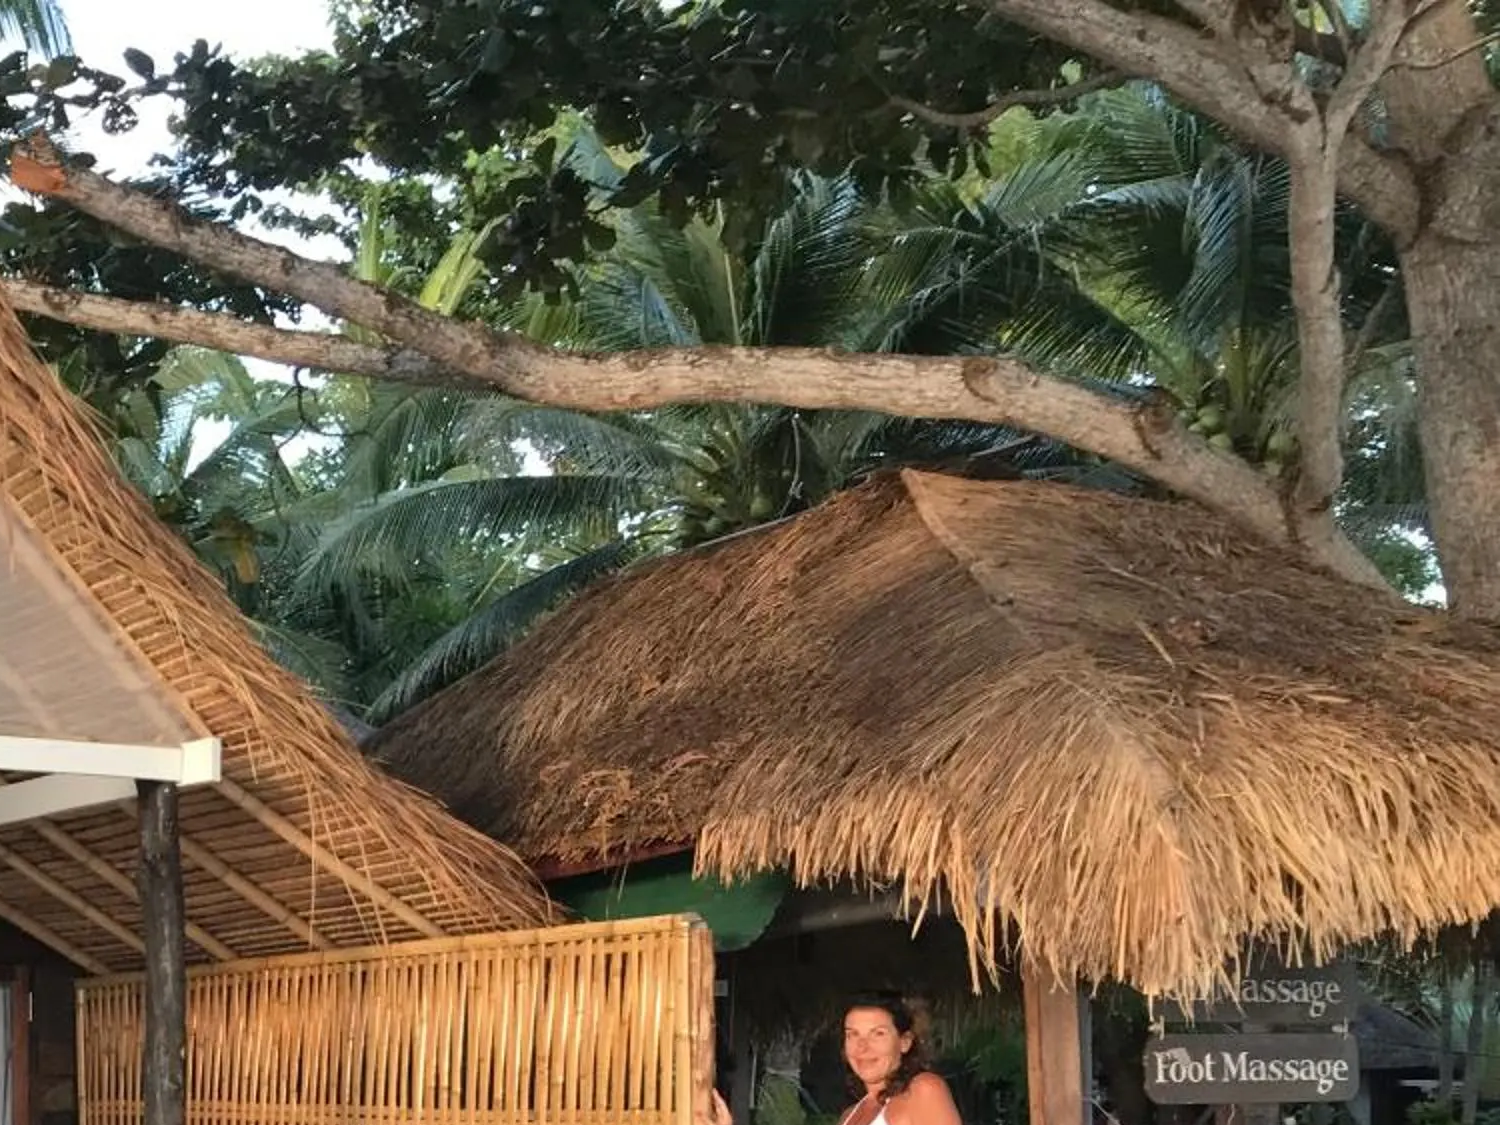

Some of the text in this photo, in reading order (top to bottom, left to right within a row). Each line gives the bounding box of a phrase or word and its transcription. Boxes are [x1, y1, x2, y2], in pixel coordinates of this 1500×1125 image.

[1215, 976, 1341, 1018] assage
[1154, 1051, 1349, 1095] Foot Massage
